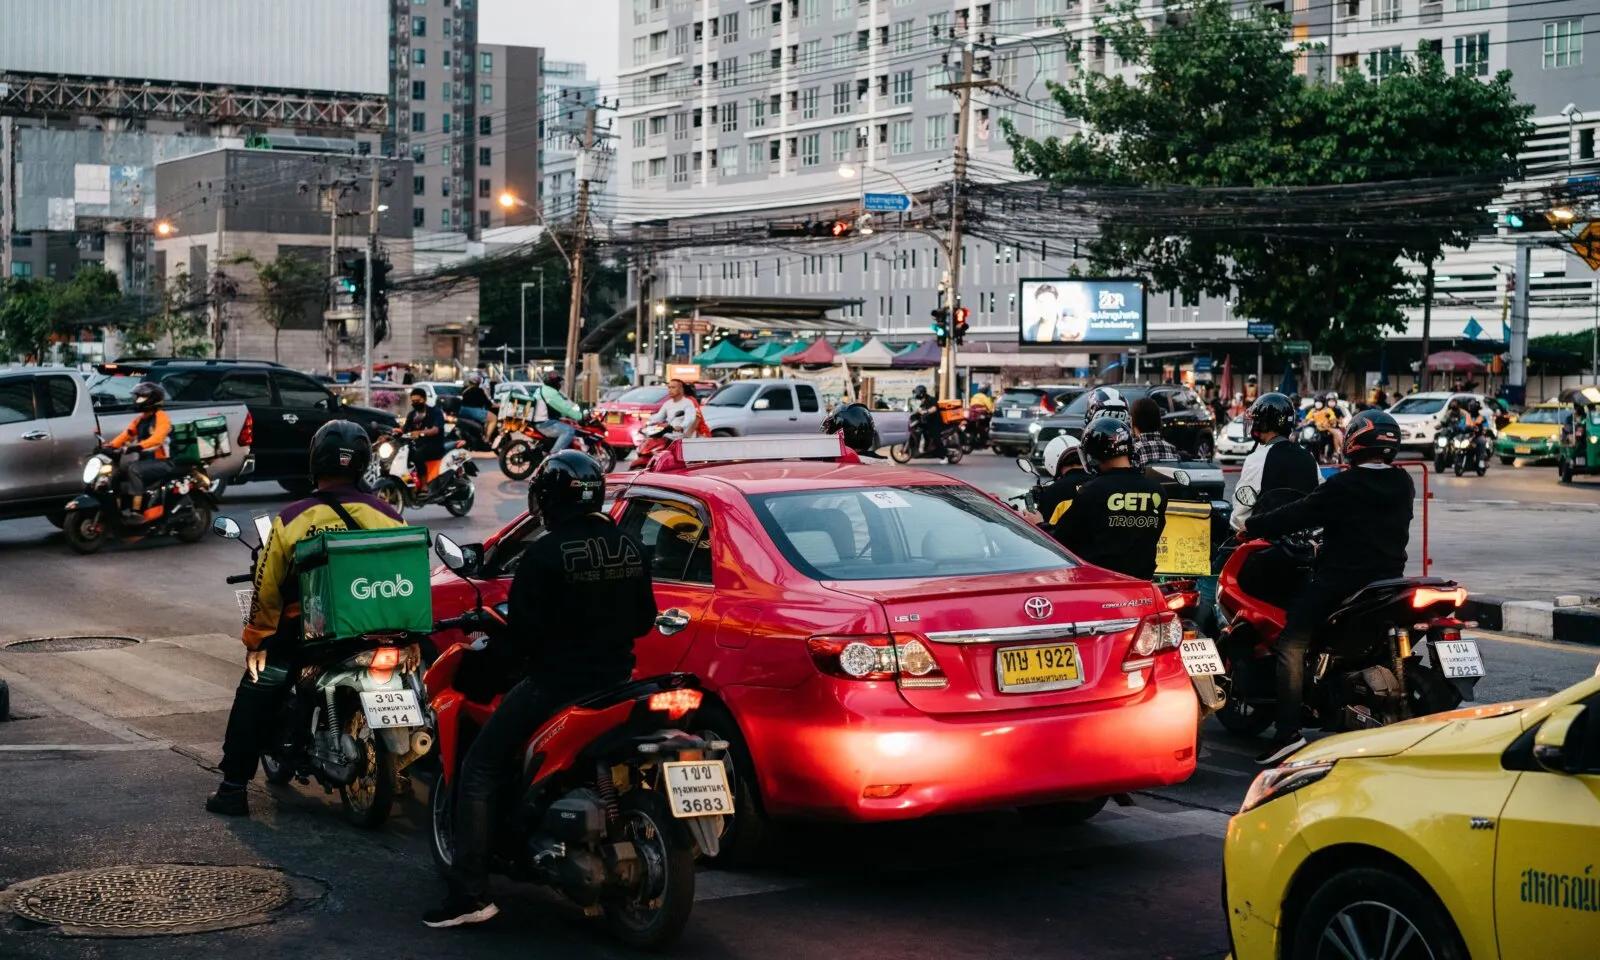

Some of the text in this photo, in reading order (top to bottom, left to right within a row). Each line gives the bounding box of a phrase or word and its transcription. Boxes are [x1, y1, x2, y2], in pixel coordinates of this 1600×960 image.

[1107, 492, 1162, 514] GET!
[1108, 515, 1160, 529] TROOP!
[560, 535, 642, 572] FILA
[350, 573, 414, 600] Grab
[1182, 641, 1207, 652] 8กข
[1036, 647, 1075, 670] 1922
[1188, 662, 1218, 674] 1335
[1448, 665, 1479, 677] 7825
[1015, 673, 1069, 685] กรงเทพมหานคร
[375, 693, 404, 704] 3ขจ
[381, 714, 410, 725] 614
[682, 797, 724, 813] 3683
